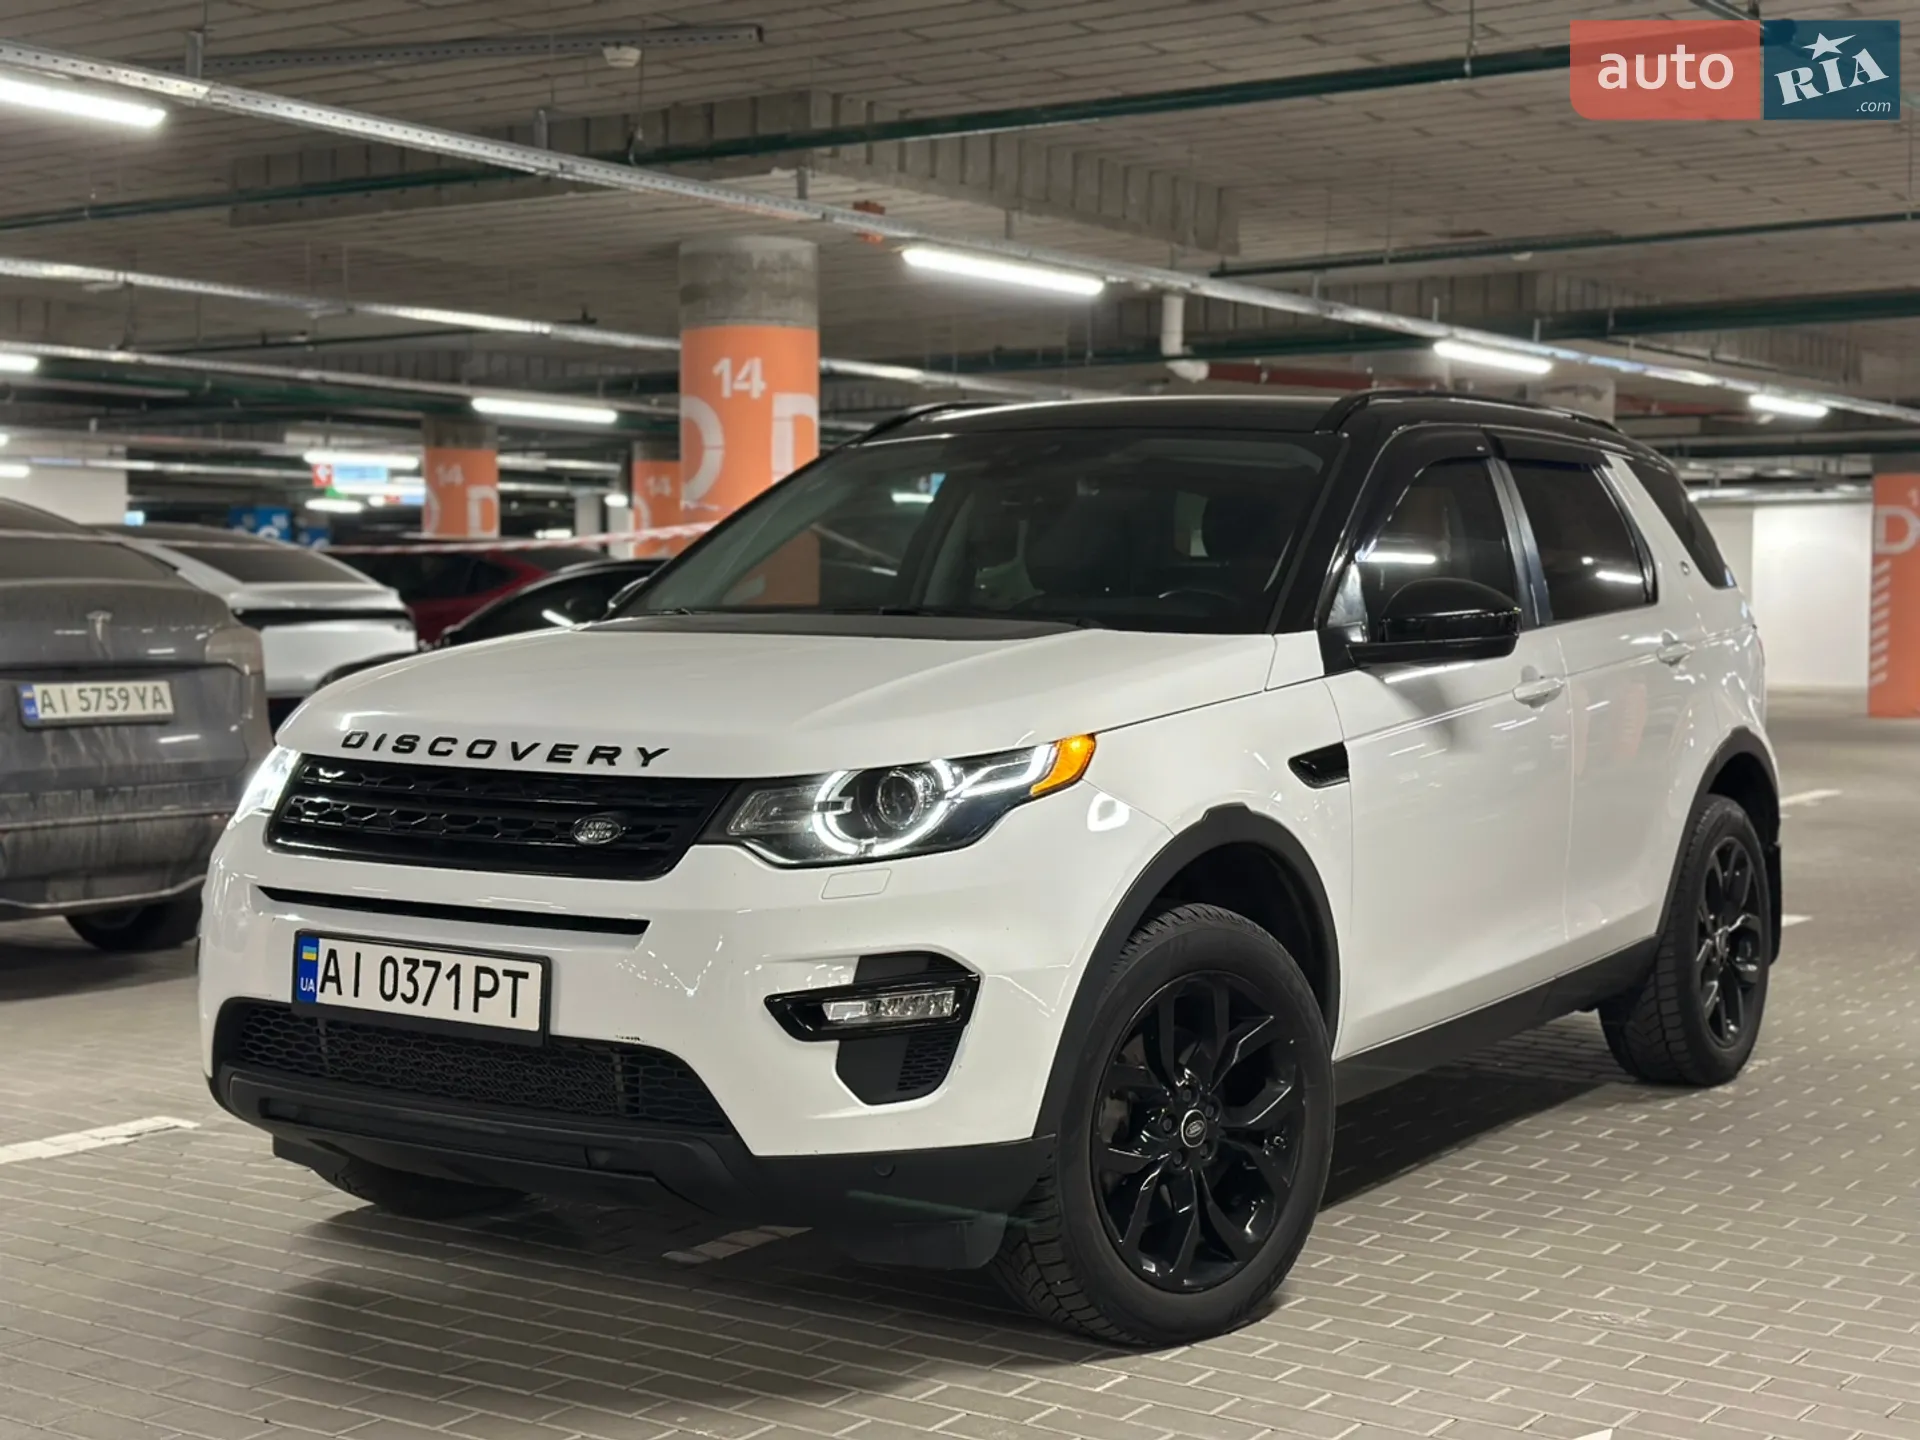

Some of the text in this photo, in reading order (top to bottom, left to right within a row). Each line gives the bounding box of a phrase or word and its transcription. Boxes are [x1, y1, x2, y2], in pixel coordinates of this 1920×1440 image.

[712, 357, 767, 399] 14
[1874, 505, 1920, 555] D
[340, 730, 670, 768] DISCOVERY
[300, 976, 316, 993] UA
[319, 948, 362, 998] AI
